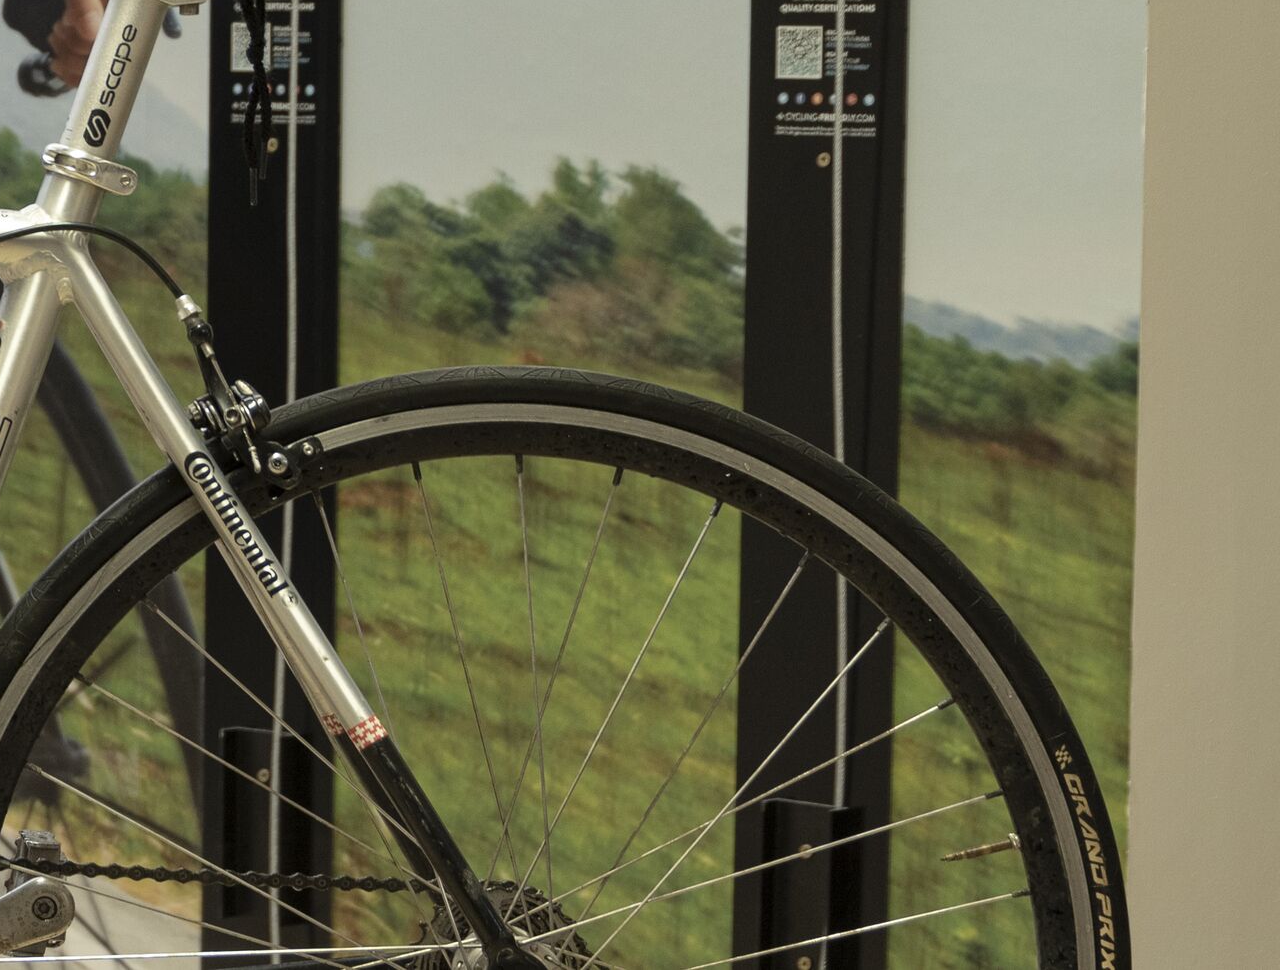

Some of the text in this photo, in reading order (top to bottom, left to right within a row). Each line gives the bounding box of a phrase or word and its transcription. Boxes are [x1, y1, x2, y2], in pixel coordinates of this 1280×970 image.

[99, 24, 138, 107] scape
[780, 3, 813, 14] QUALITY
[184, 451, 290, 598] Continental
[1064, 773, 1116, 970] GRAND PRIX
